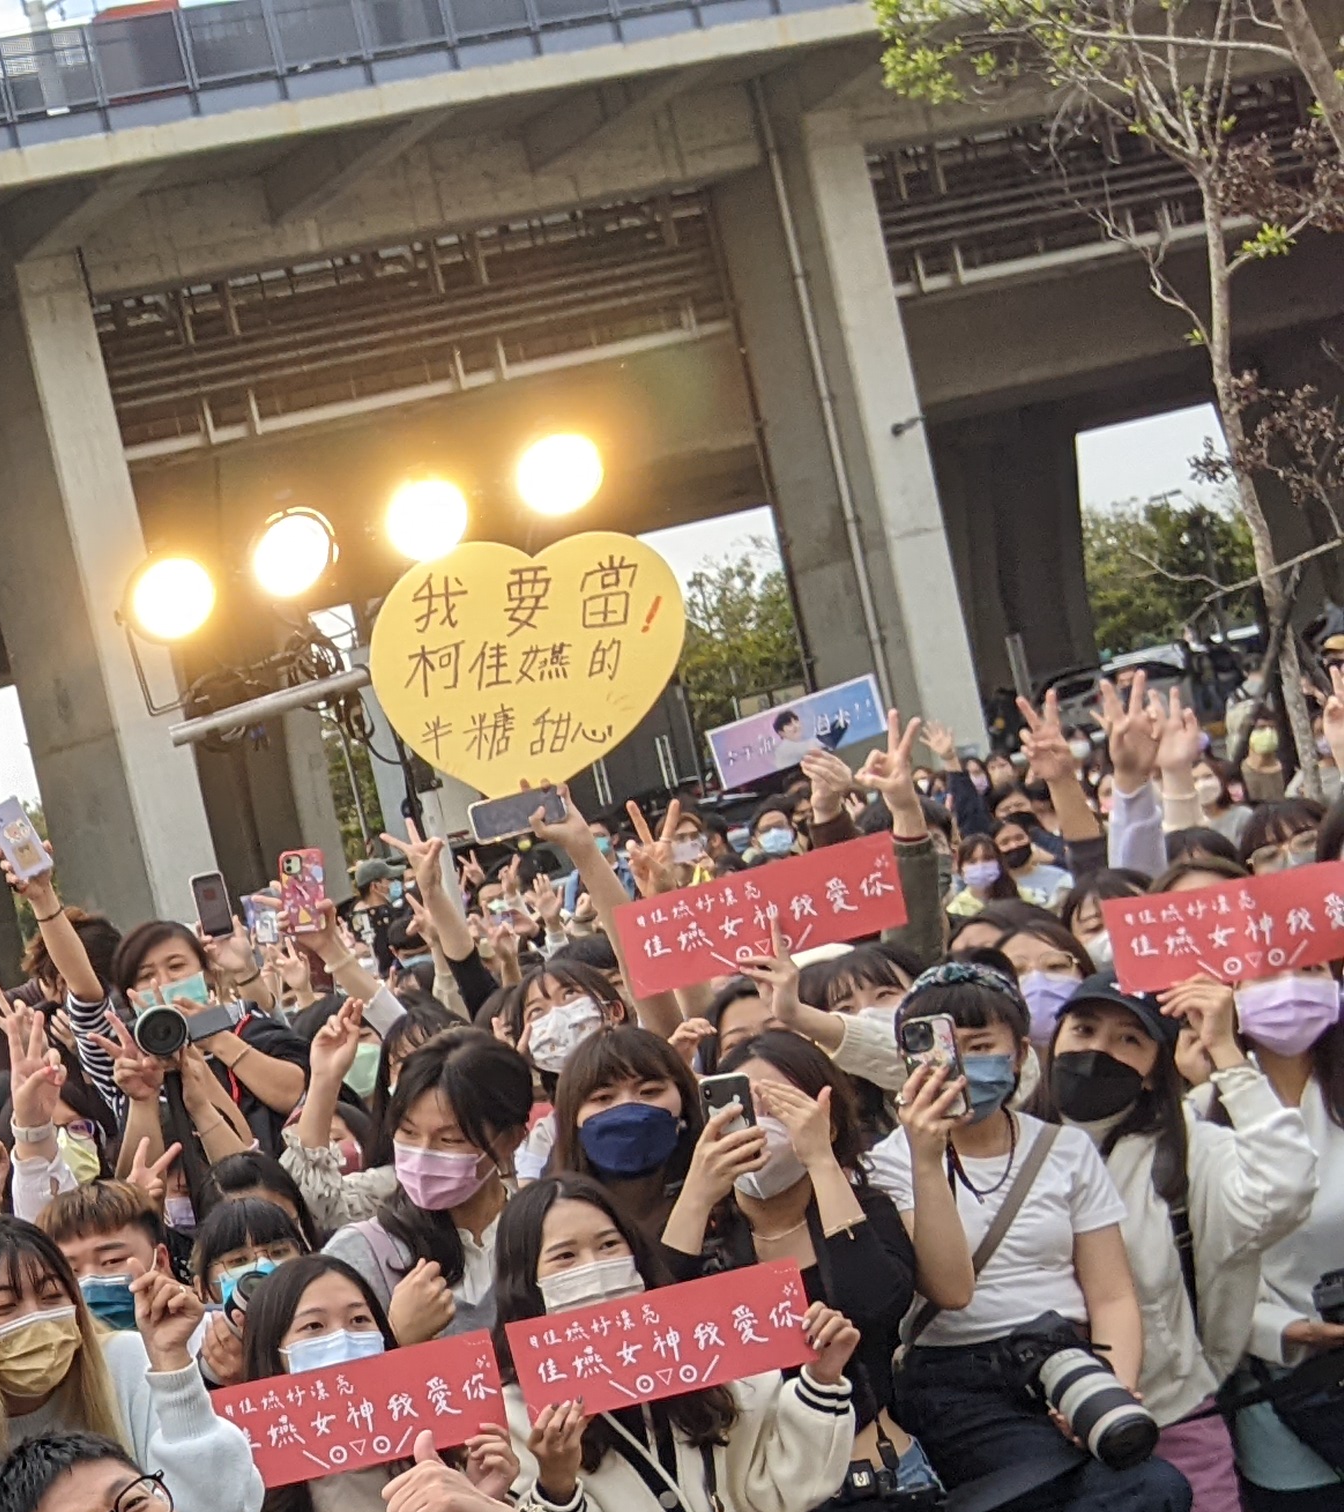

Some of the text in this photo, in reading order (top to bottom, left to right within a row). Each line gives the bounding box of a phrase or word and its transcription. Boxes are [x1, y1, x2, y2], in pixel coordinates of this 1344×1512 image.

[405, 639, 621, 697] 柯佳嬿的
[422, 704, 614, 760] 半糖甜心
[538, 1301, 804, 1383] 佳嬿女神我愛你
[224, 1374, 354, 1416] #佳嬿好漂亮
